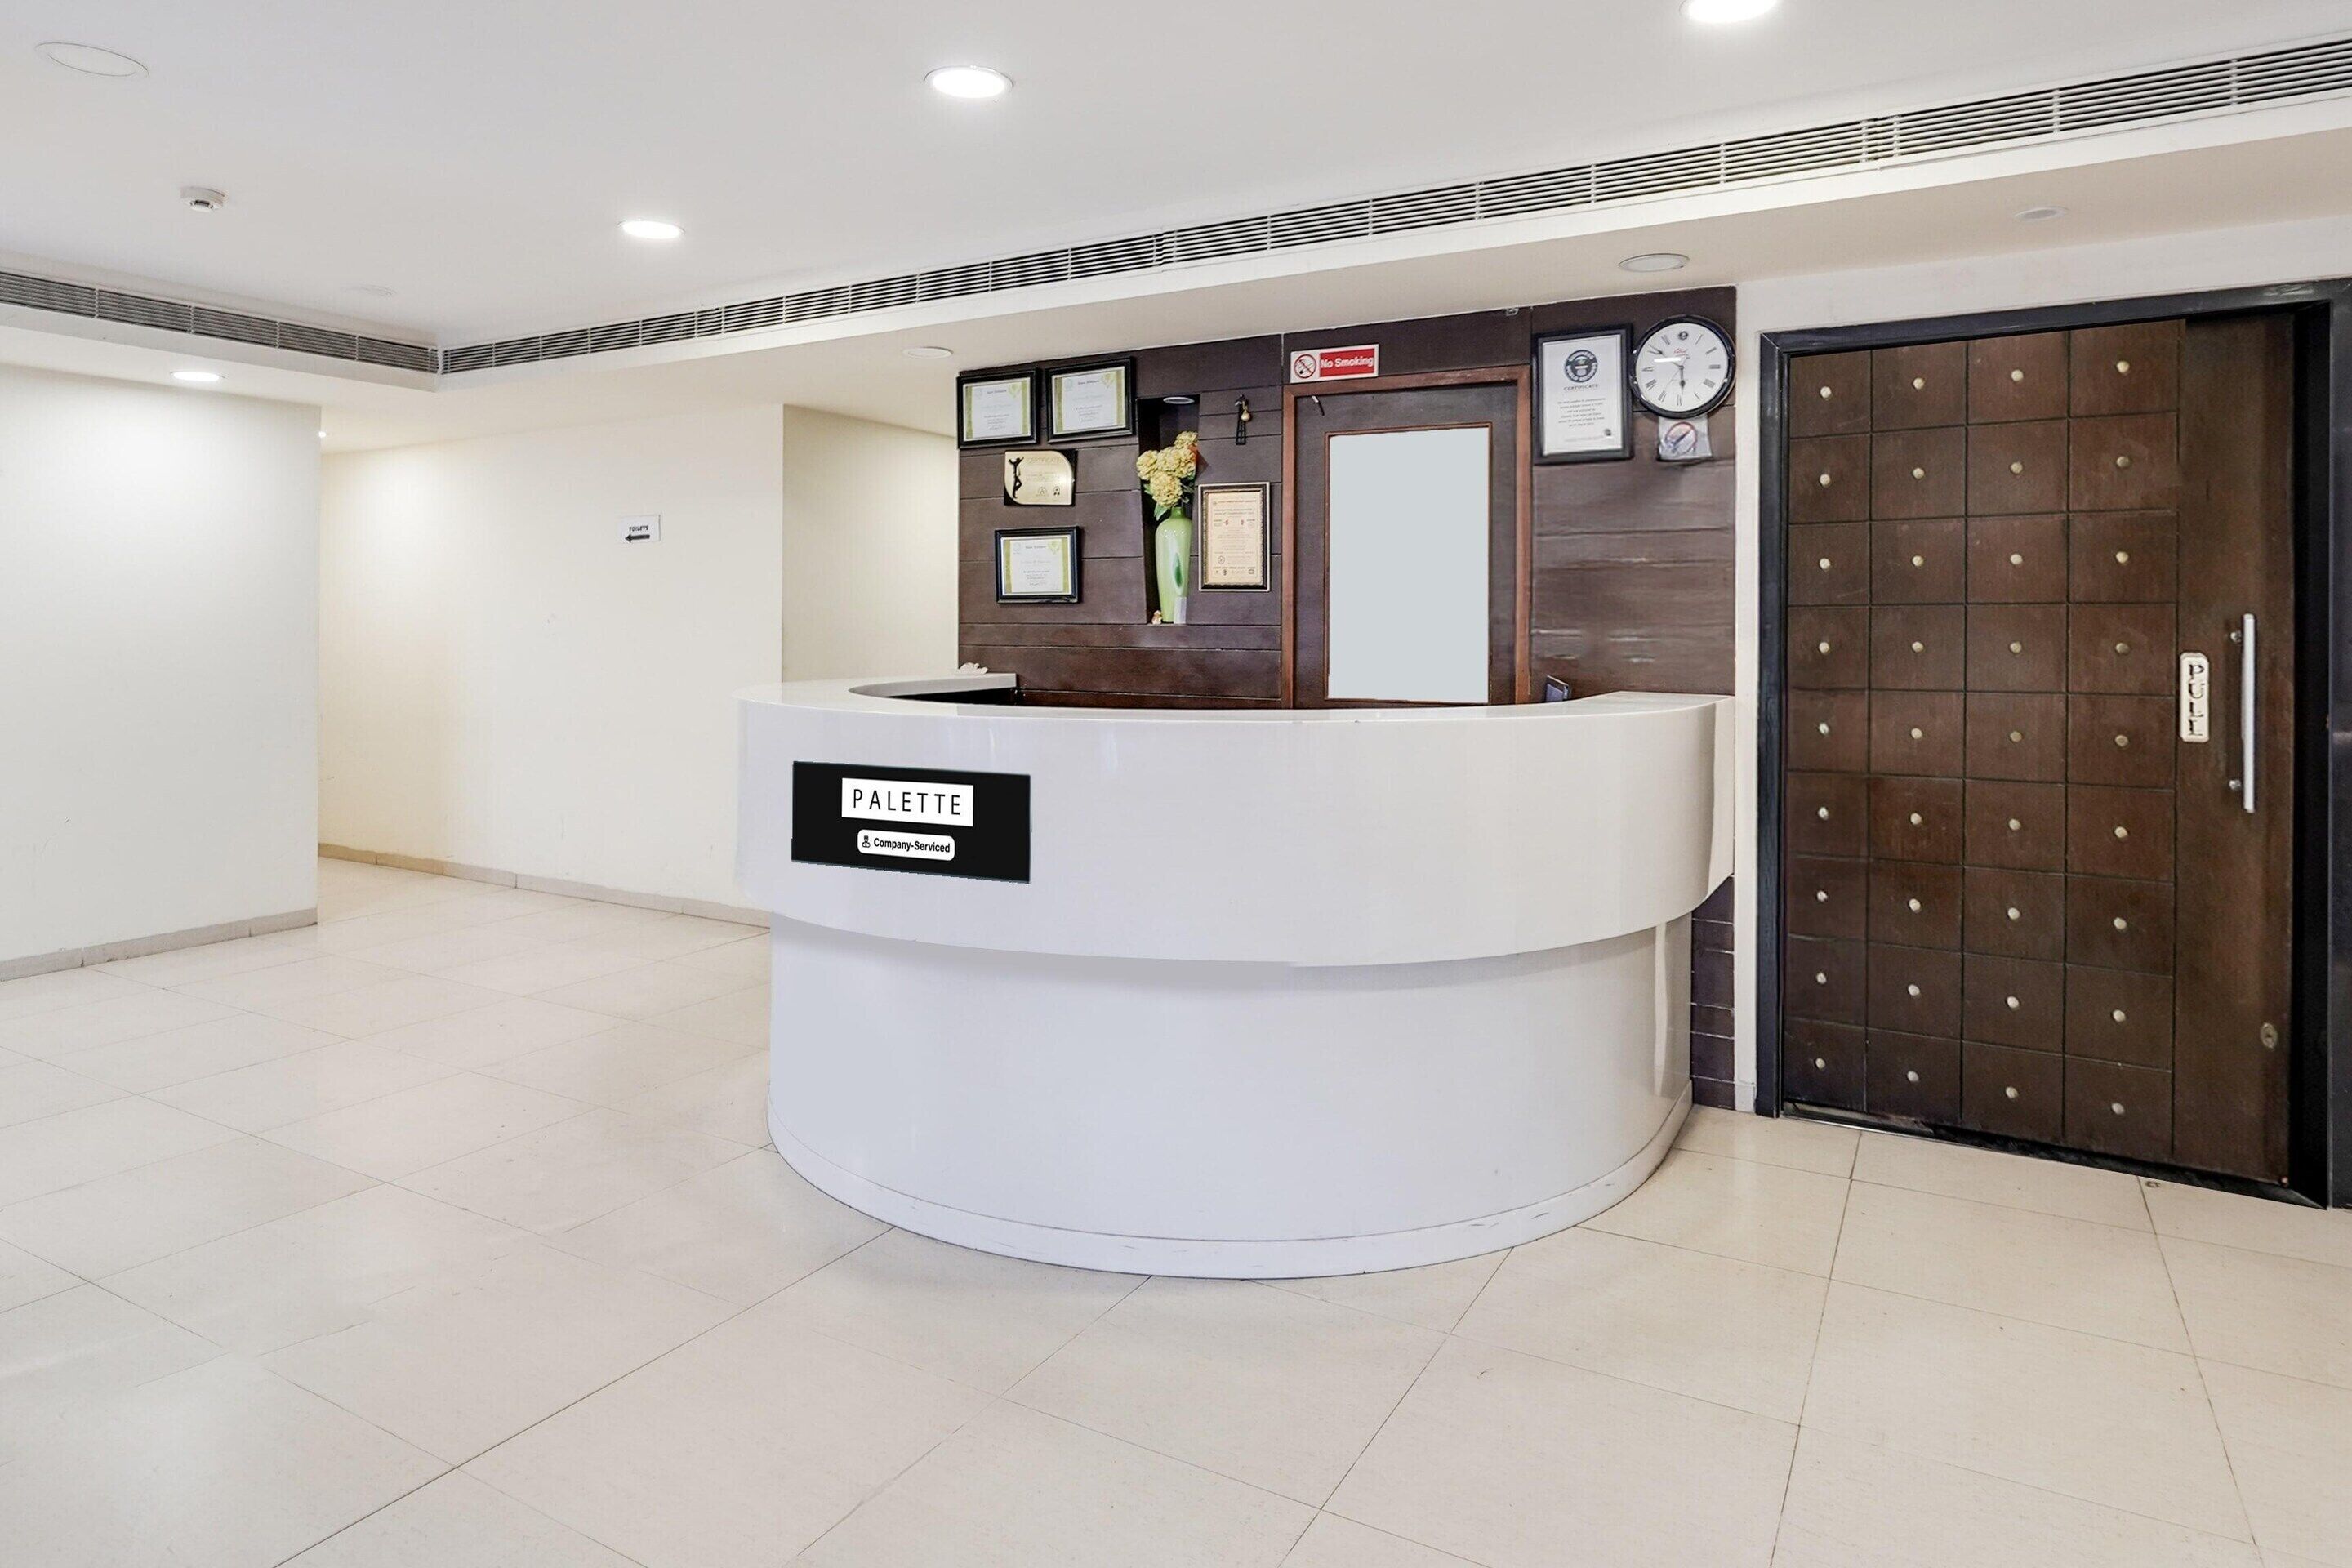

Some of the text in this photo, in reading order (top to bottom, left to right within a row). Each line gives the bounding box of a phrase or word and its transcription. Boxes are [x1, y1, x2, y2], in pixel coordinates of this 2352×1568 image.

[1321, 356, 1374, 368] No Smoking
[2187, 663, 2205, 737] PULL
[853, 788, 961, 815] PALETTE
[873, 837, 951, 853] Company-Serviced
